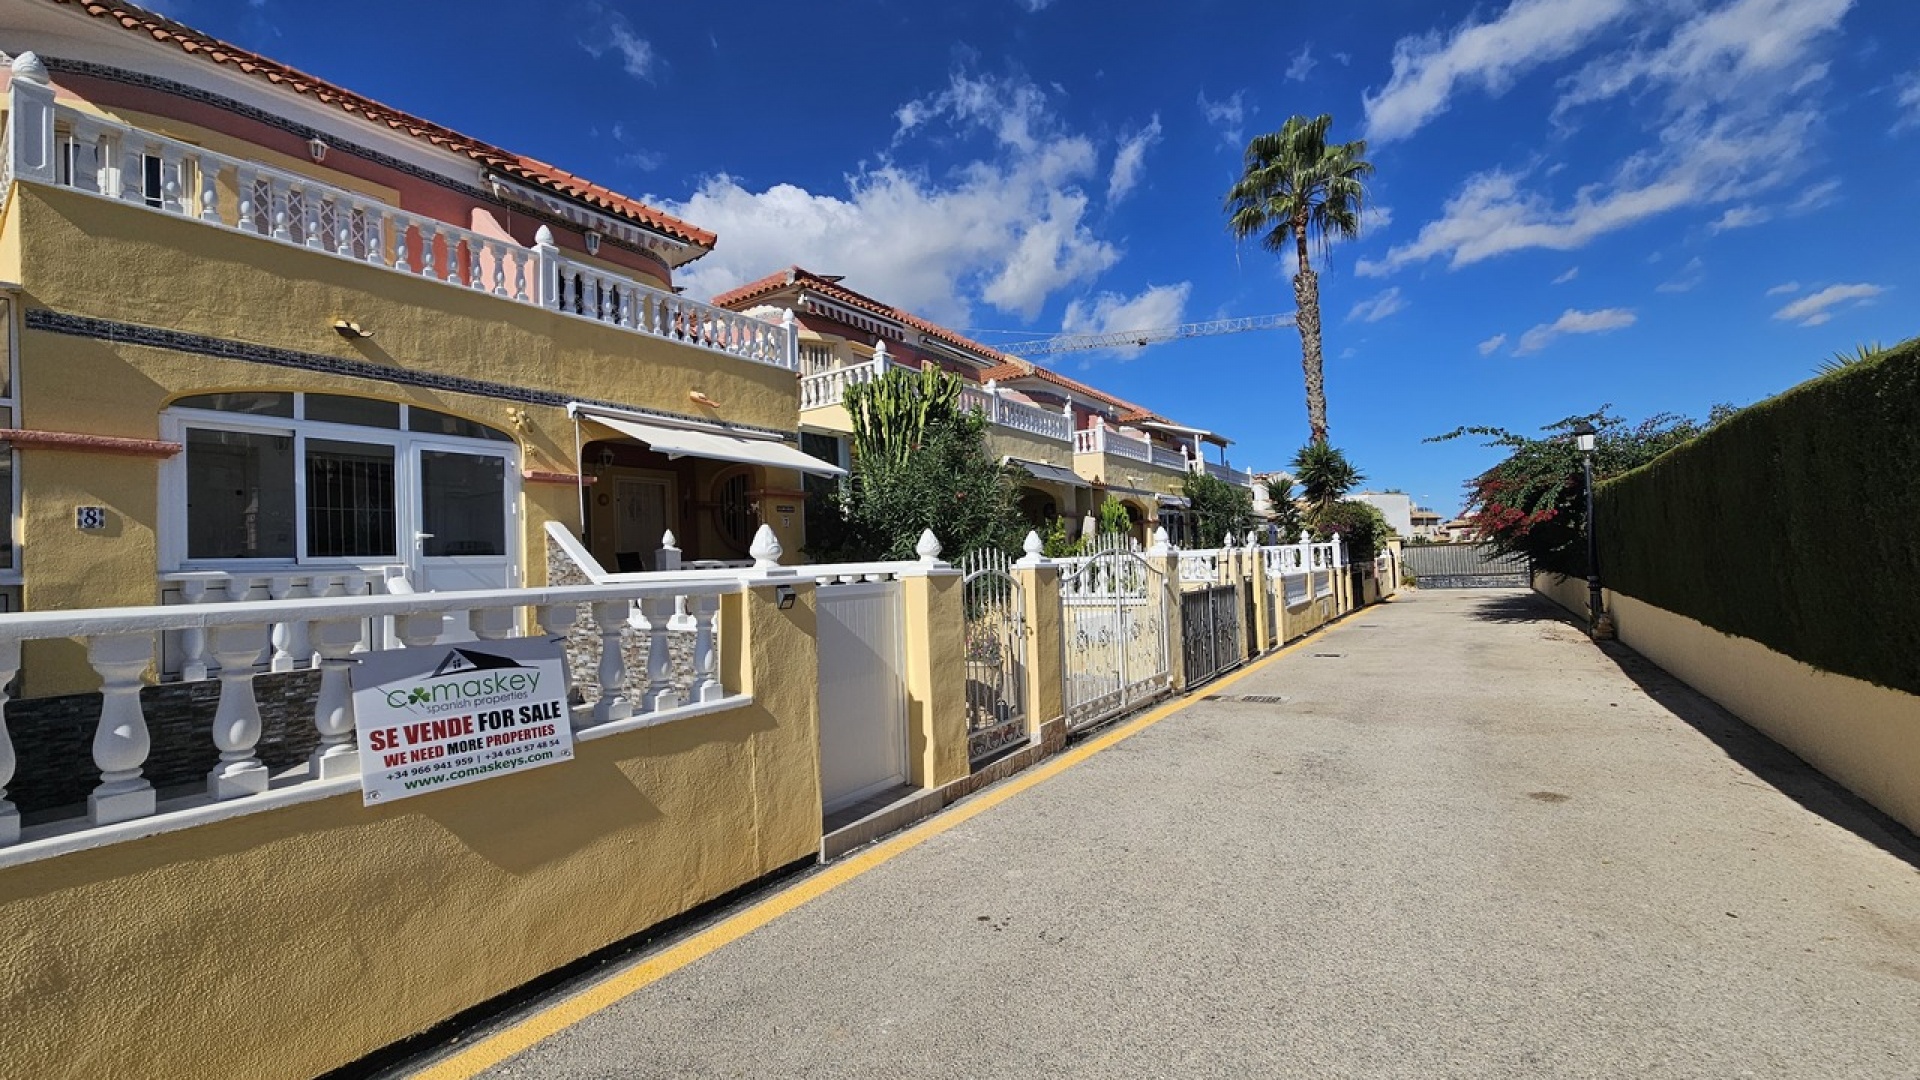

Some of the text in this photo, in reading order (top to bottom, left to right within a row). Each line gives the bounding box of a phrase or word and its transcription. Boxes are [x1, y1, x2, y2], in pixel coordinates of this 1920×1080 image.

[84, 509, 97, 527] 8
[426, 690, 528, 714] spanish properties
[369, 701, 561, 751] SE VENDE FOR SALE
[384, 724, 555, 768] WE NEED MORE PROPERTIES
[386, 771, 408, 781] +34
[411, 765, 431, 776] 966
[434, 761, 452, 773] 941
[456, 757, 473, 768] 959
[484, 750, 503, 760] +34
[505, 746, 522, 757] 615
[524, 743, 534, 752] 57
[537, 740, 548, 749] 48
[549, 738, 560, 748] 54
[404, 750, 553, 790] www.comaskeys.com
